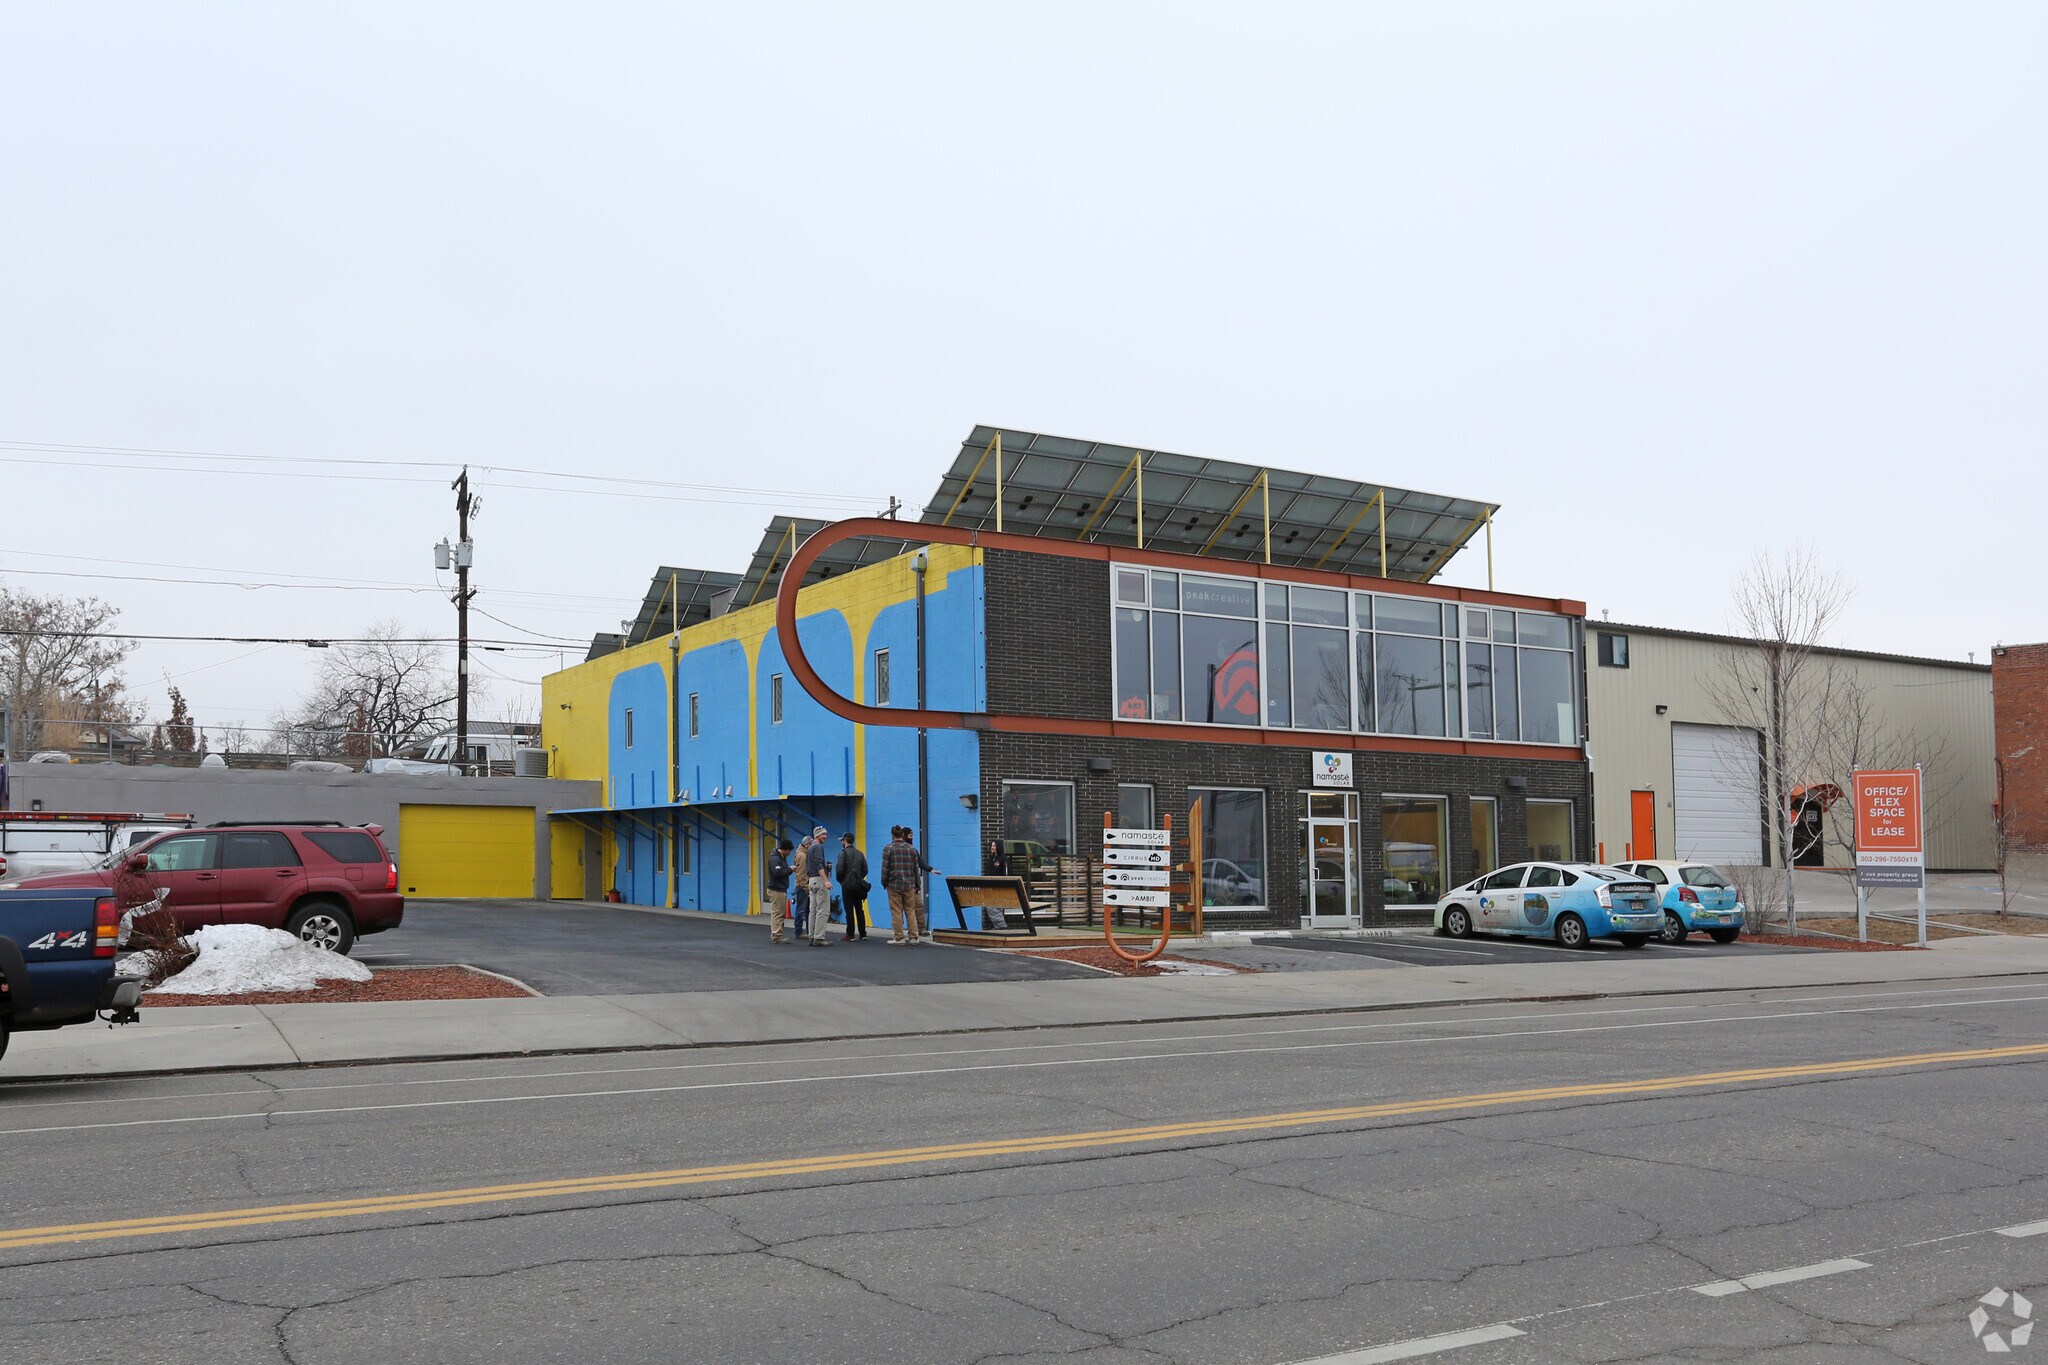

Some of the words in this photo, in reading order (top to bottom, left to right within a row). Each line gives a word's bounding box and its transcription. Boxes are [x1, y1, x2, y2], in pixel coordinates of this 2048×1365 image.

[1186, 591, 1250, 605] peakcreative
[1317, 773, 1349, 781] namasté
[1864, 786, 1909, 797] OFFICE/
[1873, 797, 1900, 807] FLEX
[1869, 808, 1905, 817] SPACE
[1121, 832, 1164, 840] namasté
[1871, 827, 1905, 836] LEASE
